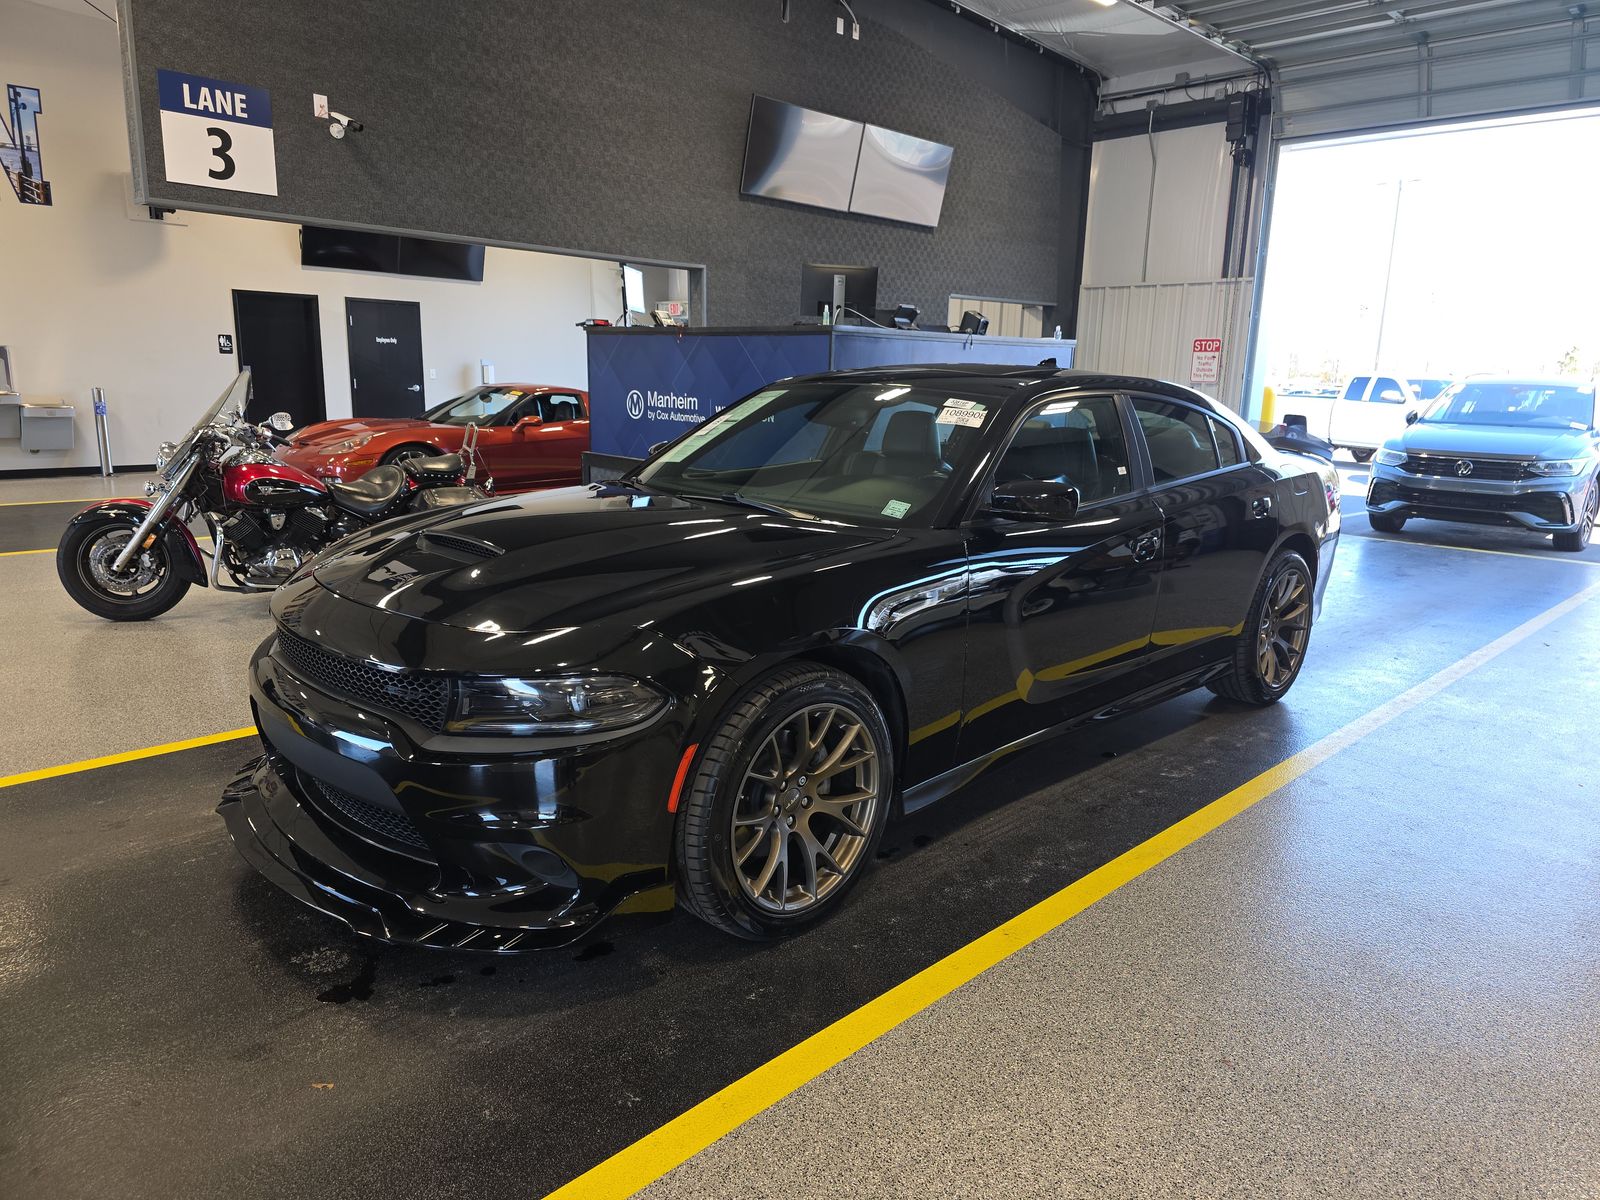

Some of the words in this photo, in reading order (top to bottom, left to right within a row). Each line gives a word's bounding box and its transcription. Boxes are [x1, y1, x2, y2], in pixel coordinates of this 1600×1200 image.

[182, 83, 248, 118] LANE
[206, 127, 236, 181] 3
[1194, 341, 1220, 352] STOP
[647, 391, 698, 410] Manheim
[647, 410, 655, 421] by
[656, 410, 669, 420] Cox
[670, 411, 706, 423] Automotive
